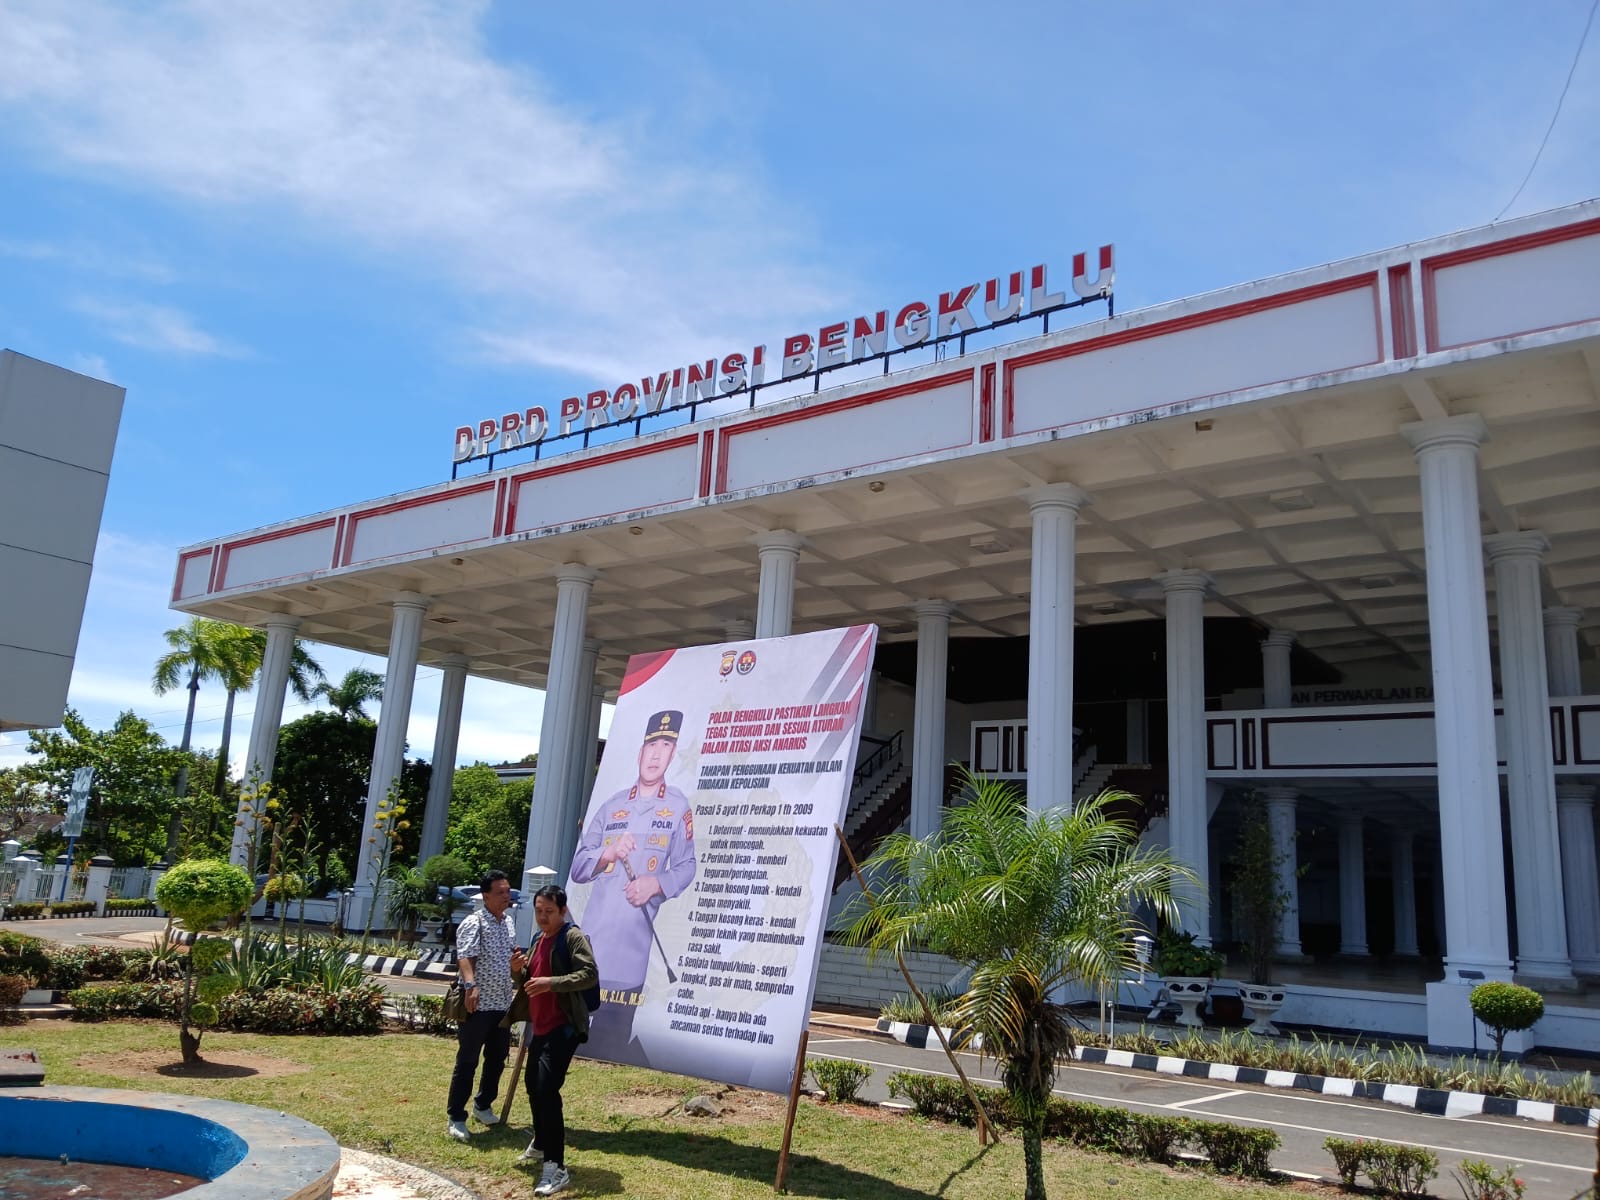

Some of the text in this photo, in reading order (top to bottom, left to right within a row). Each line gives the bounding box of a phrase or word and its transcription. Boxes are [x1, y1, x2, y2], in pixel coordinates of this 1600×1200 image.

[453, 243, 1115, 462] DPRD PROVINSI BENGKULU
[1314, 688, 1412, 704] PERWAKILAN
[708, 711, 732, 725] POLDA
[734, 708, 773, 722] BENGKULU
[774, 706, 812, 719] PASTIKAN
[705, 718, 844, 739] TEGAS TERUKUR DAN SESUAI ATURAN
[701, 737, 807, 754] DALAM ATASI AKSI ANARKIS
[701, 760, 842, 776] TAHAPAN PENGGUNAAN KEKUATAN DALAM
[697, 777, 770, 790] TINDAKAN KEPOLISIAN
[695, 804, 715, 816] Pasal
[716, 805, 722, 814] 5
[723, 804, 739, 816] ayat
[750, 804, 776, 816] Perkap
[793, 804, 813, 815] 2009
[651, 820, 673, 830] POLRI
[748, 826, 793, 837] menunjukkan
[795, 826, 827, 836] kekuatan
[710, 840, 728, 849] untuk
[735, 854, 751, 864] lisan
[756, 855, 787, 865] memberi
[701, 883, 723, 894] Tangan
[725, 883, 749, 895] kosong
[751, 885, 769, 895] lunak
[776, 885, 801, 896] kendali
[698, 897, 716, 908] tanpa
[719, 913, 743, 926] kosong
[744, 915, 764, 926] keras
[770, 916, 796, 929] kendali
[691, 927, 805, 945] dengan teknik yang menimbulkan
[688, 943, 703, 952] rasa
[685, 957, 708, 969] Senjata
[710, 959, 755, 973] tumpul/kimia
[762, 965, 787, 978] seperti
[681, 972, 793, 995] tongkat, gas air mata, semprotan
[678, 988, 694, 1000] cabe.
[674, 1003, 698, 1016] Senjata
[700, 1006, 711, 1018] api
[716, 1008, 737, 1022] hanya
[738, 1010, 752, 1022] bila
[753, 1014, 767, 1026] ada
[670, 1020, 774, 1044] ancaman serius terhadap jiwa
